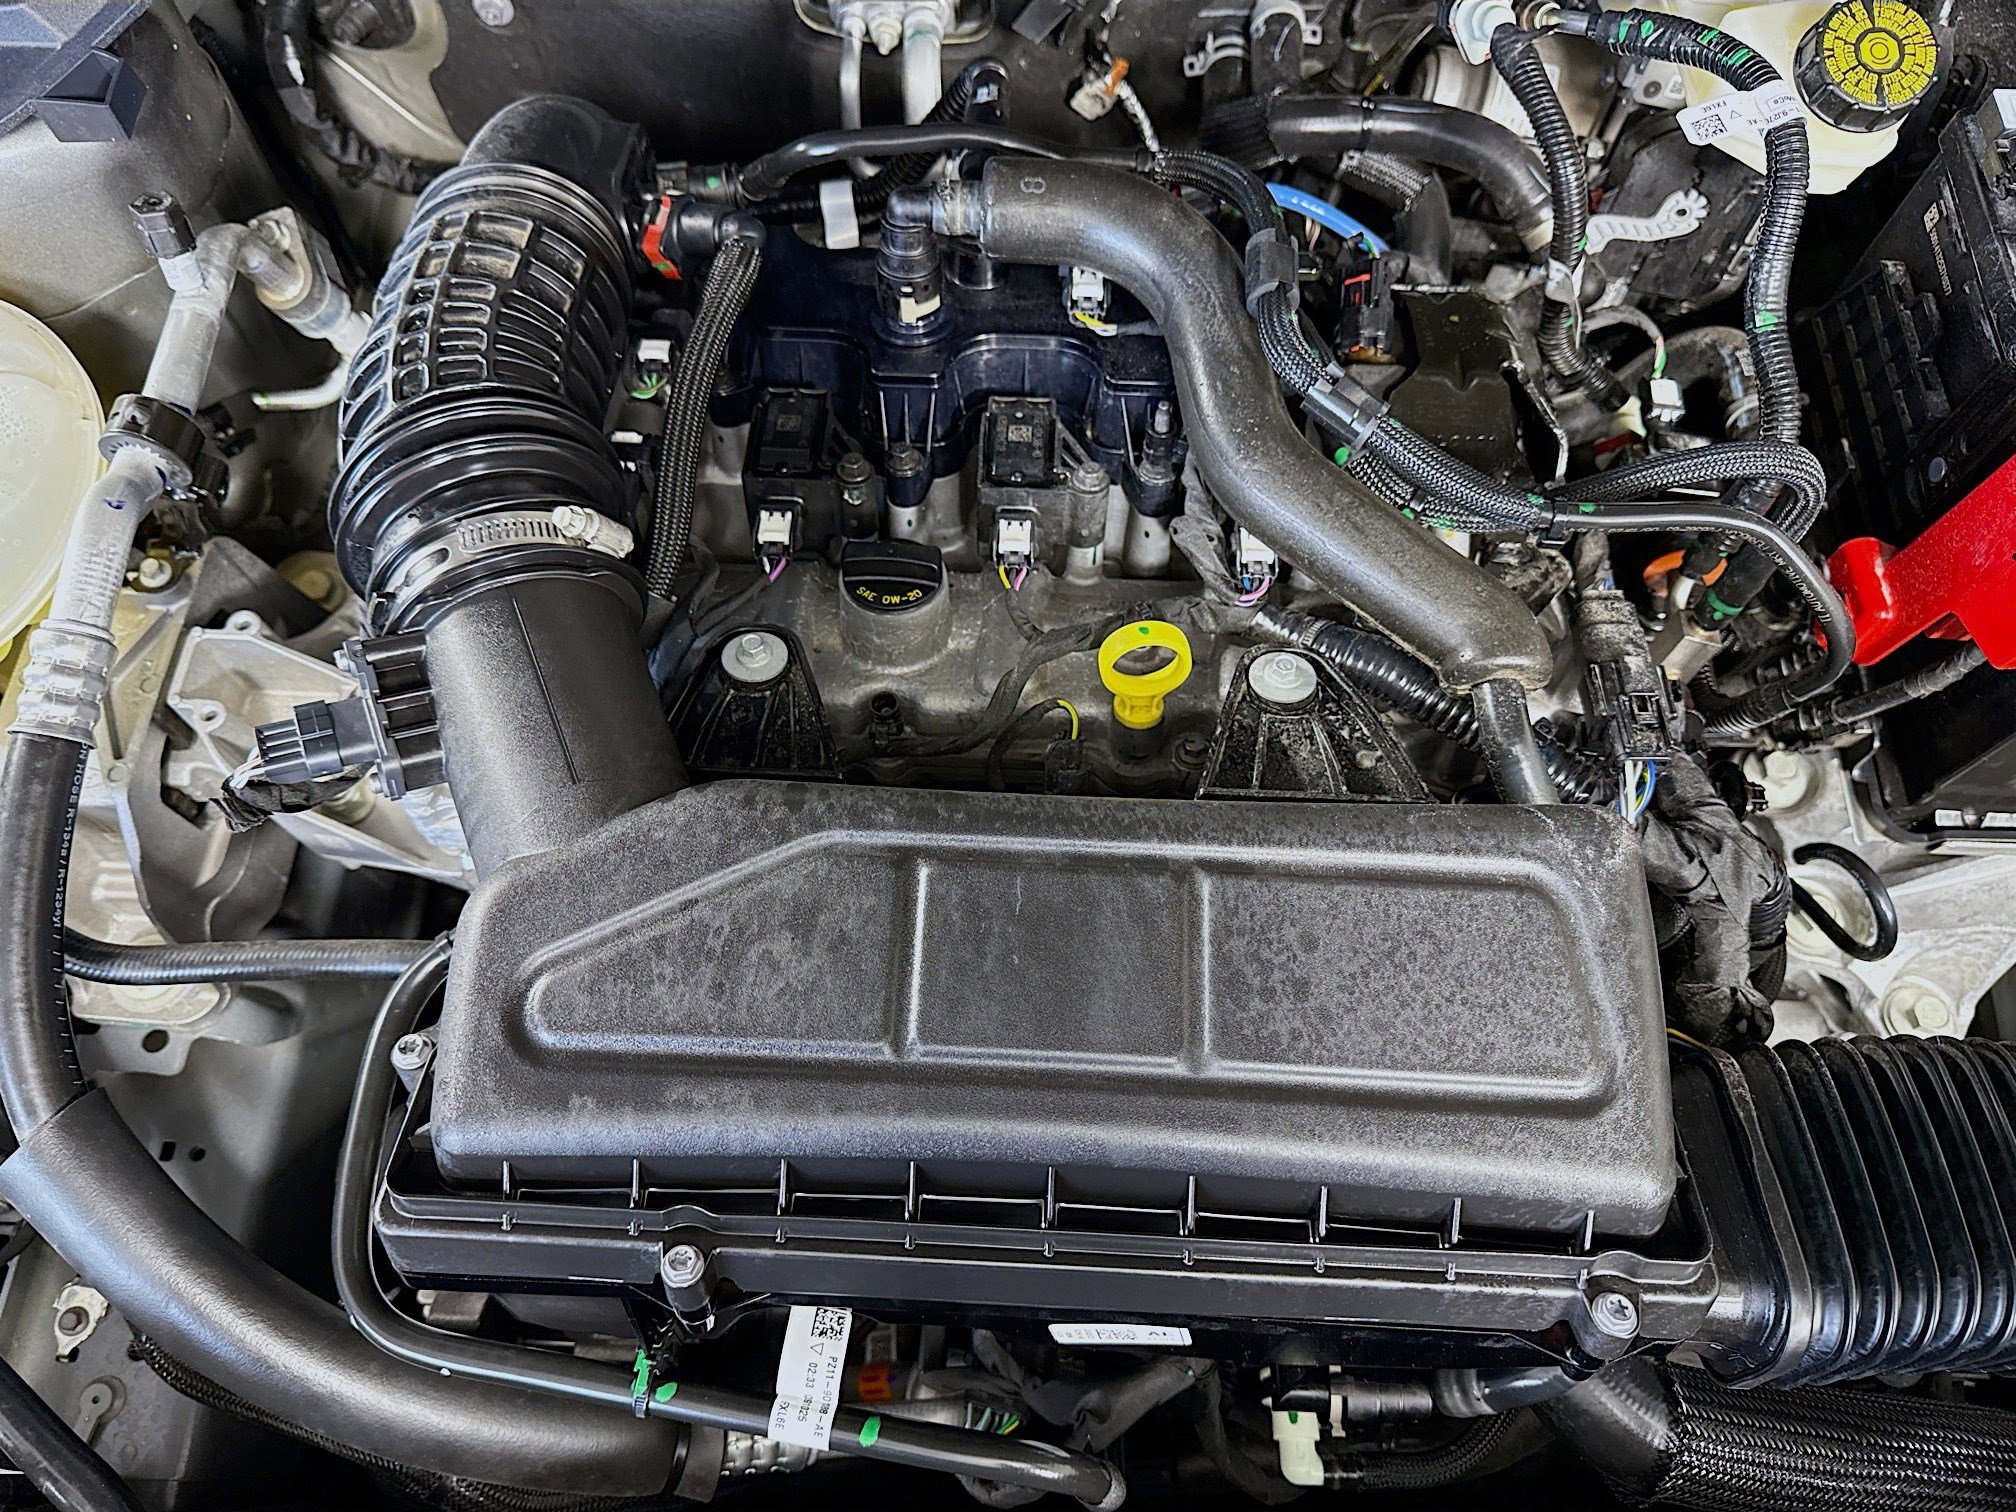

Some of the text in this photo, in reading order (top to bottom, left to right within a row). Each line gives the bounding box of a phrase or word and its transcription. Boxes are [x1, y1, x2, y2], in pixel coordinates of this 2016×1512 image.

[1923, 35, 1937, 46] LE
[1840, 79, 1878, 106] CONTAINER
[856, 586, 923, 605] SAE 0W-20
[69, 763, 84, 804] HOSE
[60, 807, 75, 857] R-134a
[52, 868, 66, 929] R-1234yf
[805, 1362, 818, 1389] 02:33
